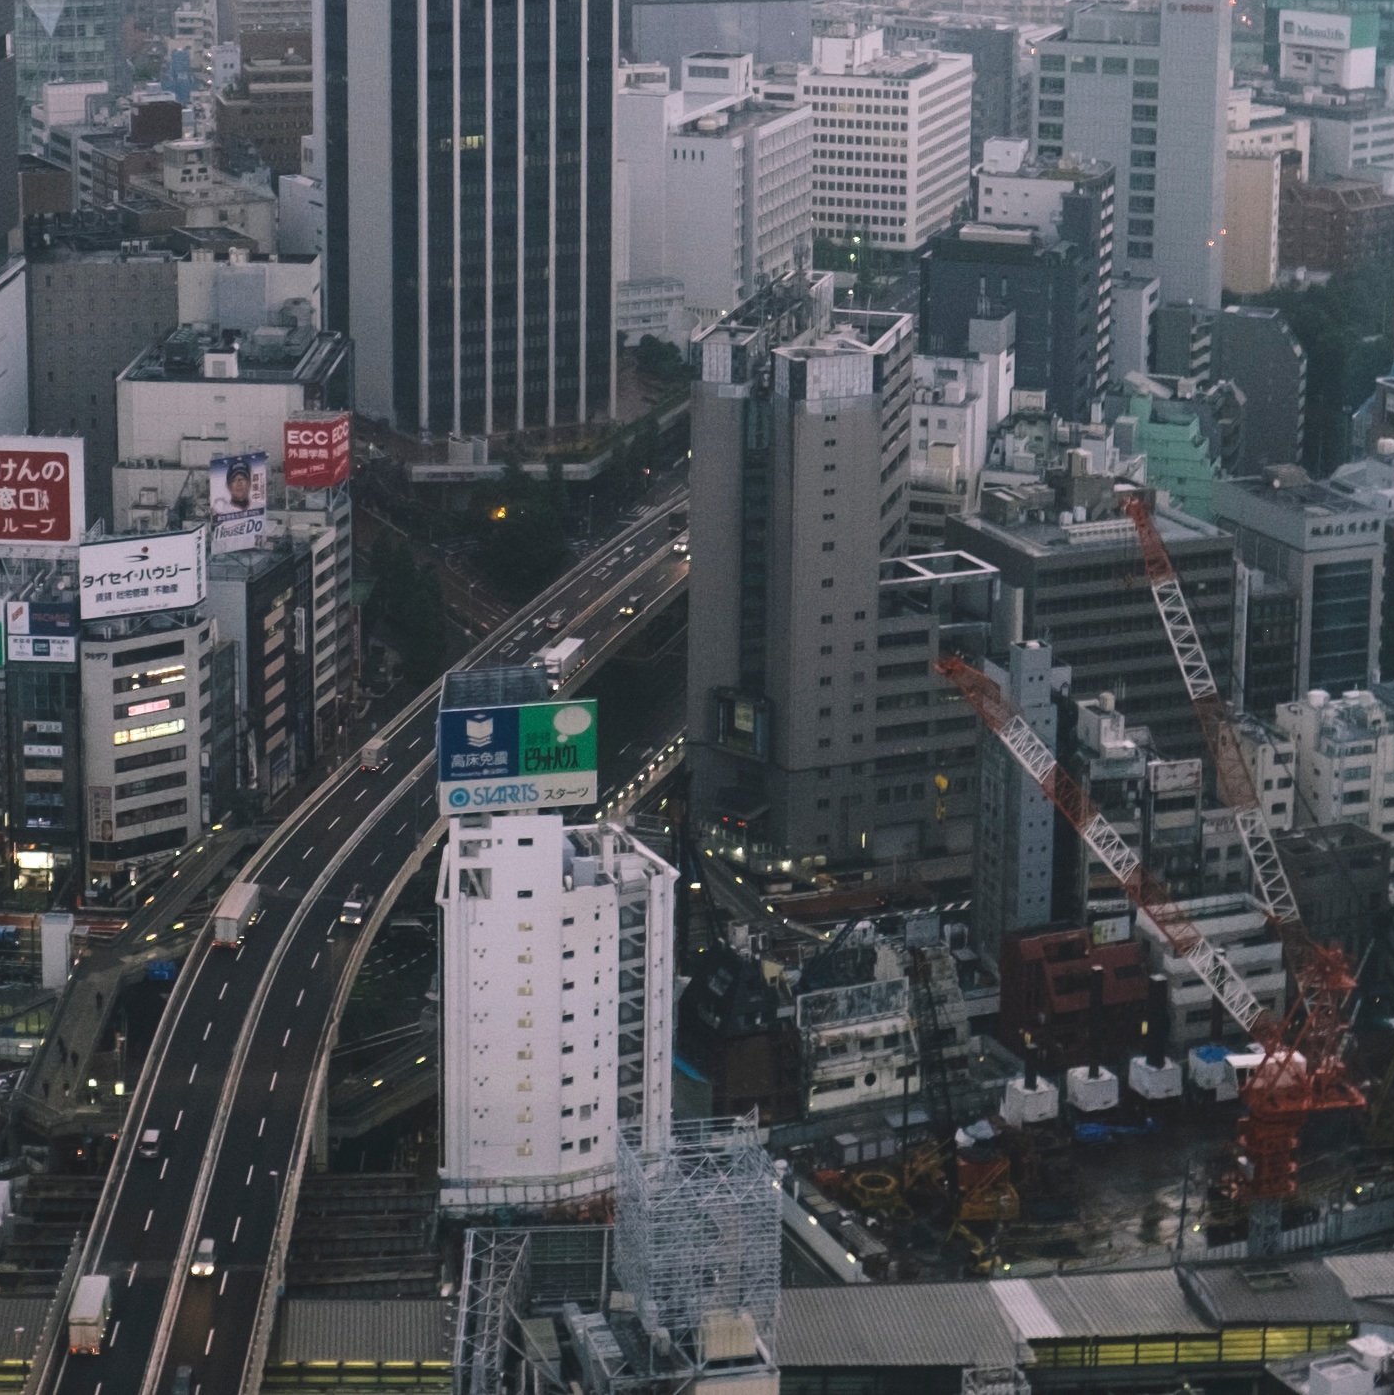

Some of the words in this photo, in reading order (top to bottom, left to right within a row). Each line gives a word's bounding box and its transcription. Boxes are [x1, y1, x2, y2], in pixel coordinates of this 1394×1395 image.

[1297, 25, 1345, 40] Manulife
[287, 430, 328, 445] ECC
[288, 448, 329, 459] 外語学院
[82, 563, 191, 588] タイセイ・ハウジー
[153, 583, 179, 596] 不動産
[451, 751, 508, 768] 高床免震
[544, 786, 589, 801] スターツ
